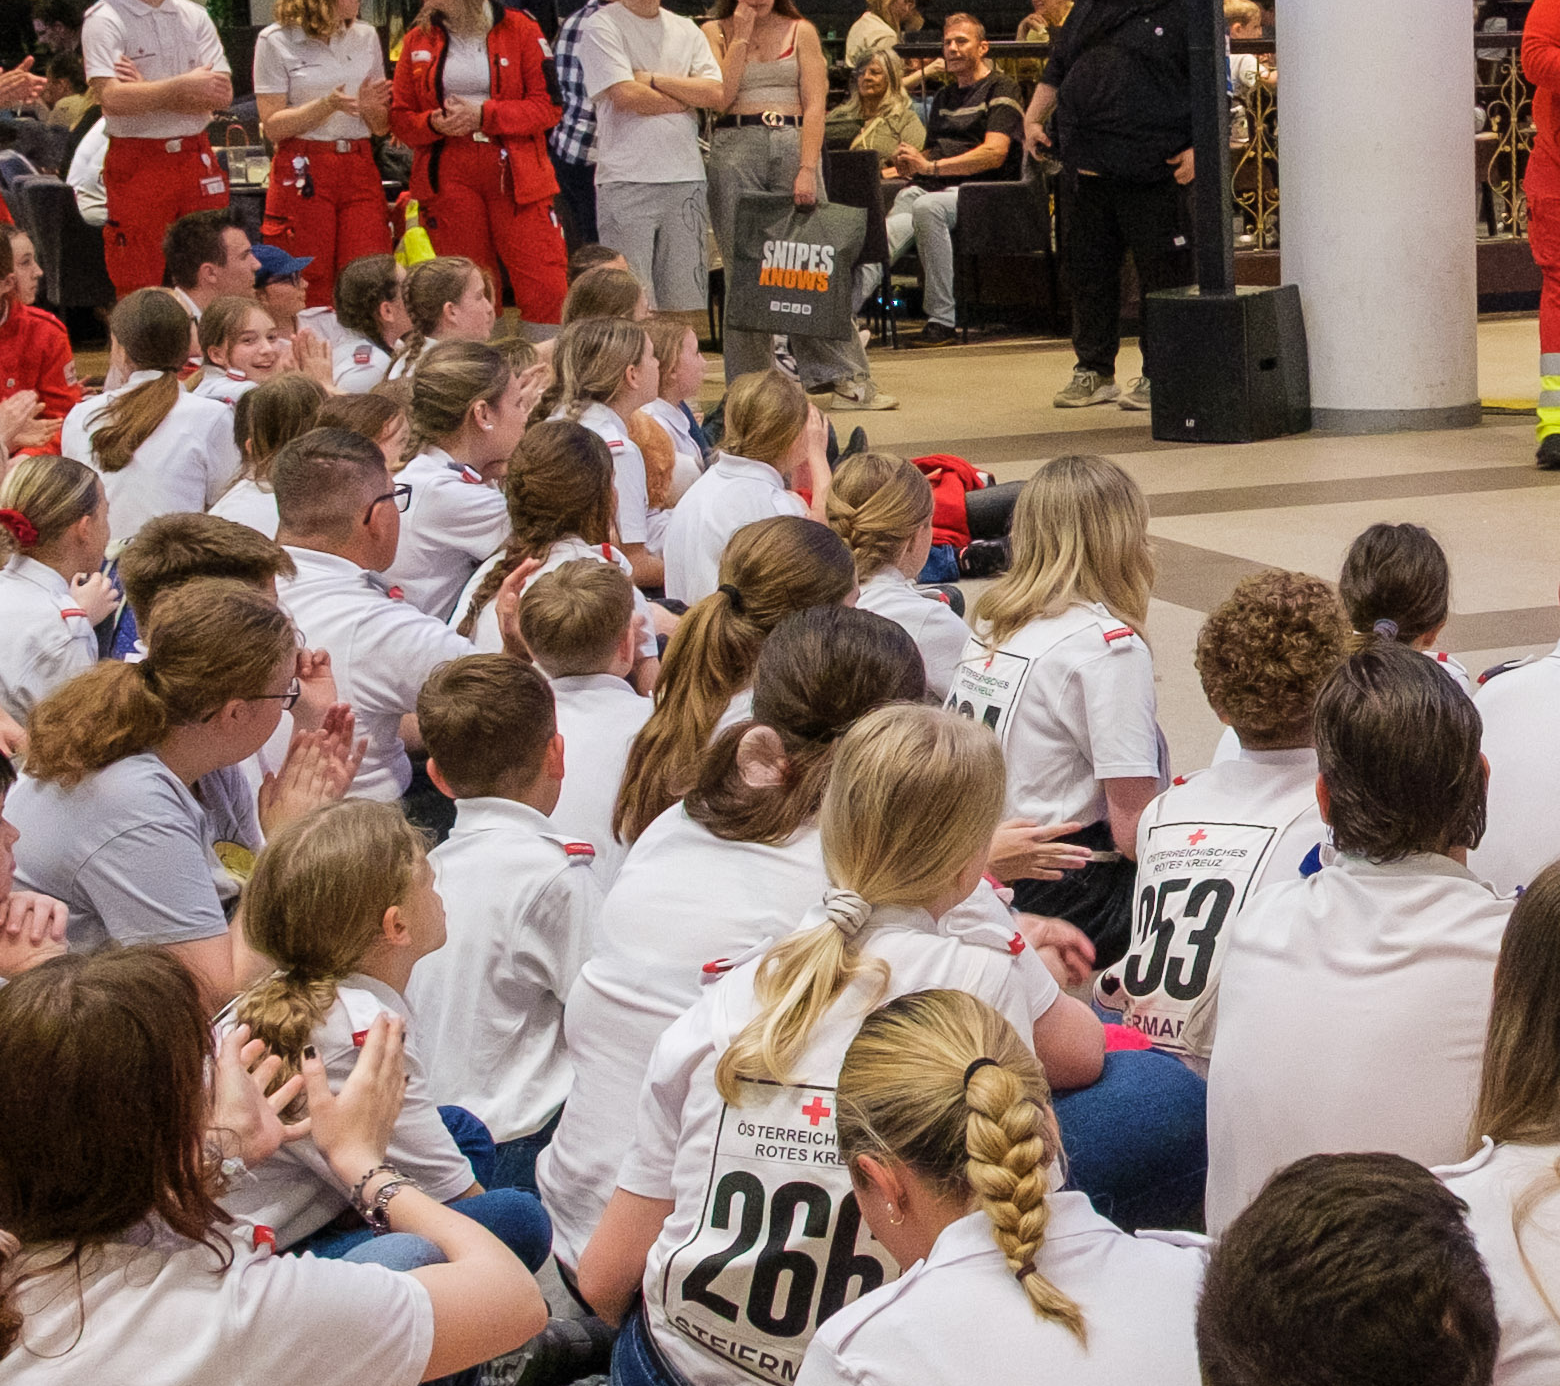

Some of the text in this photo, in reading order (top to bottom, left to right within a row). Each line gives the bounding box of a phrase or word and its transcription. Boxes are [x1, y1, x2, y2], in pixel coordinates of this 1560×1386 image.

[761, 240, 835, 276] SNIPES
[758, 267, 829, 293] KNOWS
[1153, 859, 1184, 875] ROTES
[754, 1143, 808, 1162] ROTES
[681, 1169, 885, 1339] 266
